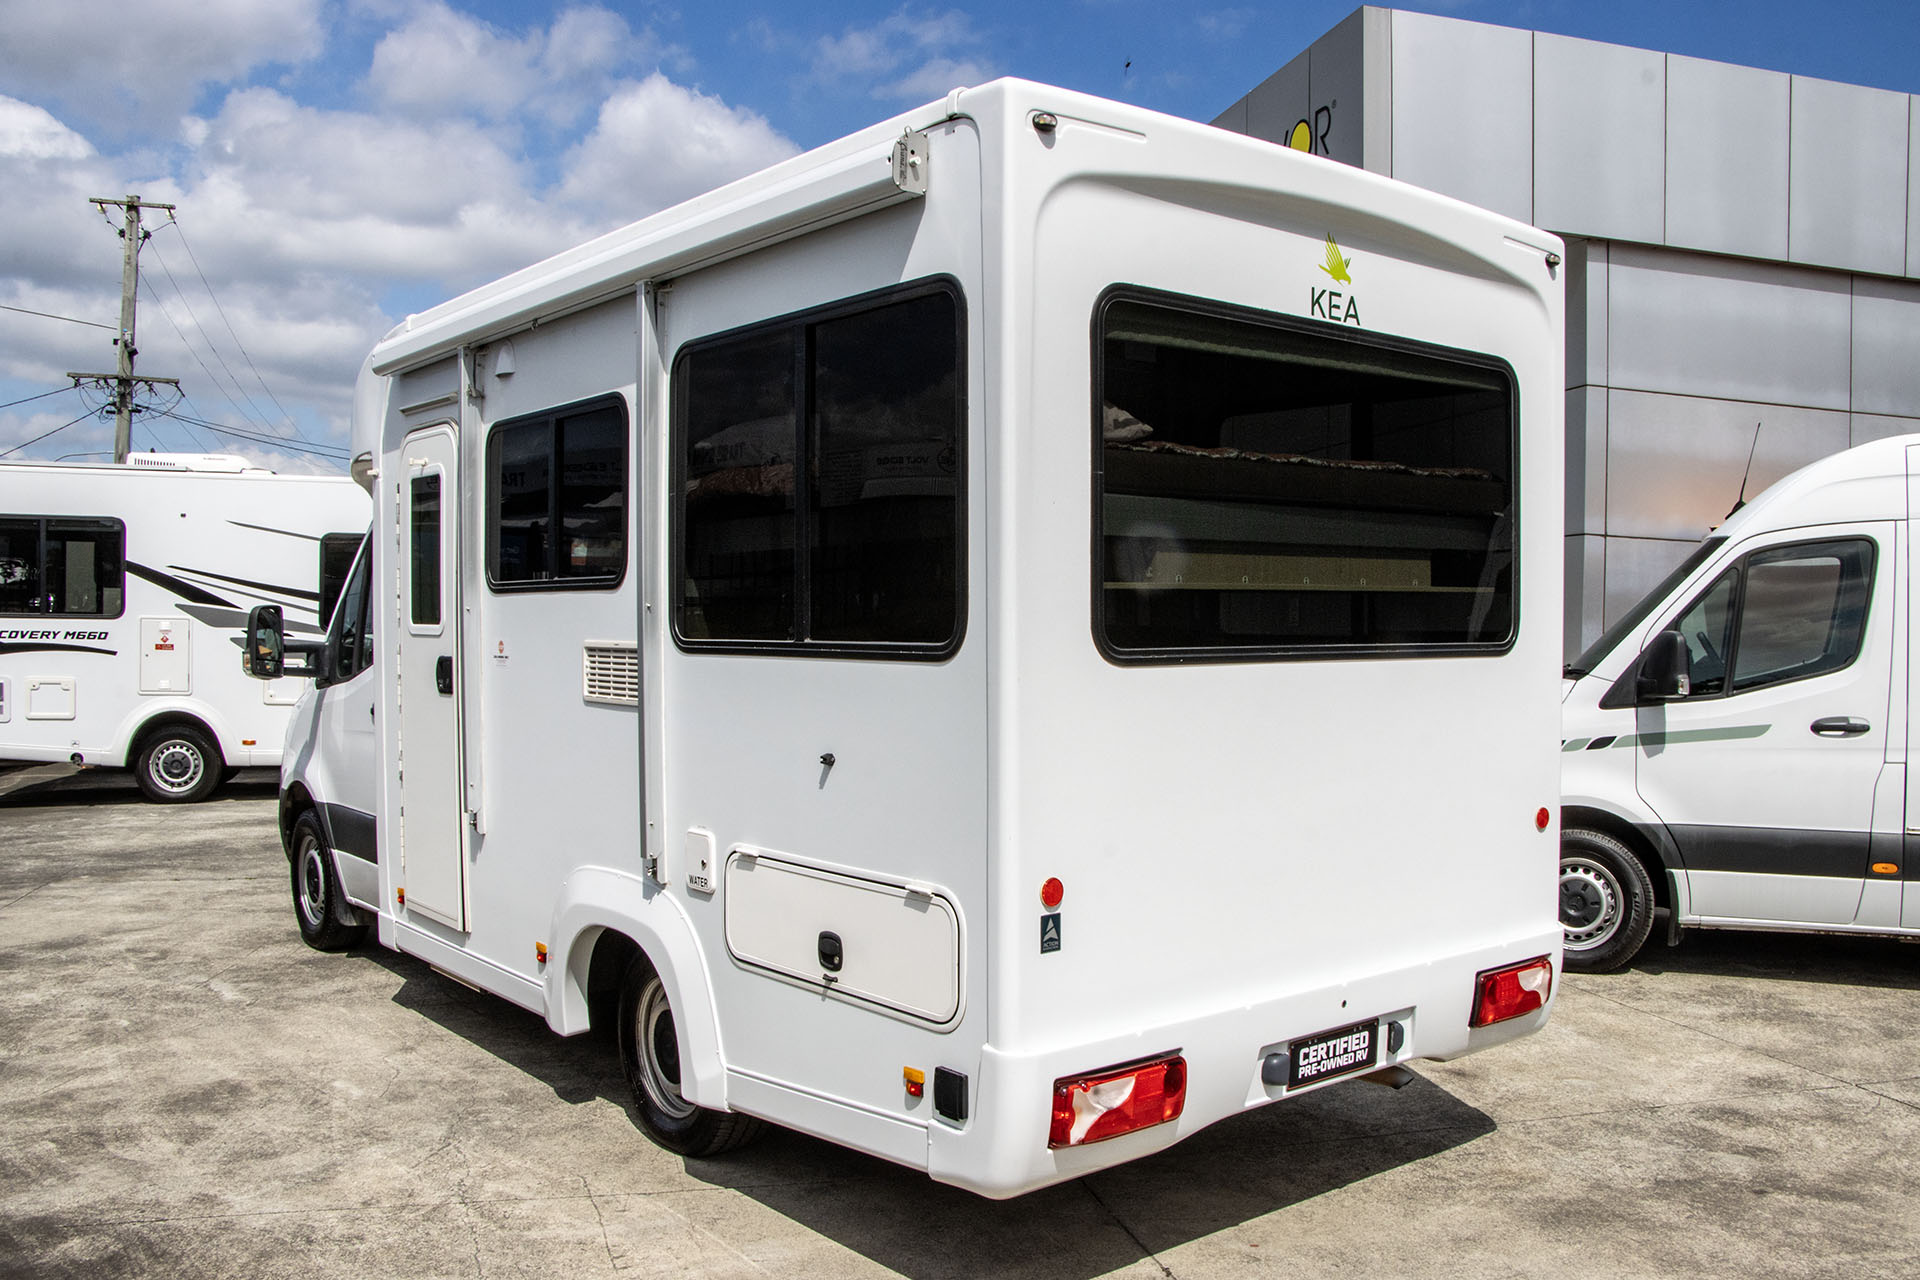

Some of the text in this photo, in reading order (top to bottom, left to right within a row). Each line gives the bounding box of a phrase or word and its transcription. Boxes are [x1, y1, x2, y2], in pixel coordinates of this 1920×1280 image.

[1311, 286, 1360, 326] KEA
[63, 631, 109, 640] M660
[688, 874, 709, 888] WATER
[1298, 1031, 1369, 1066] CERTIFIED
[1298, 1048, 1369, 1079] PRE-OWNED RV
